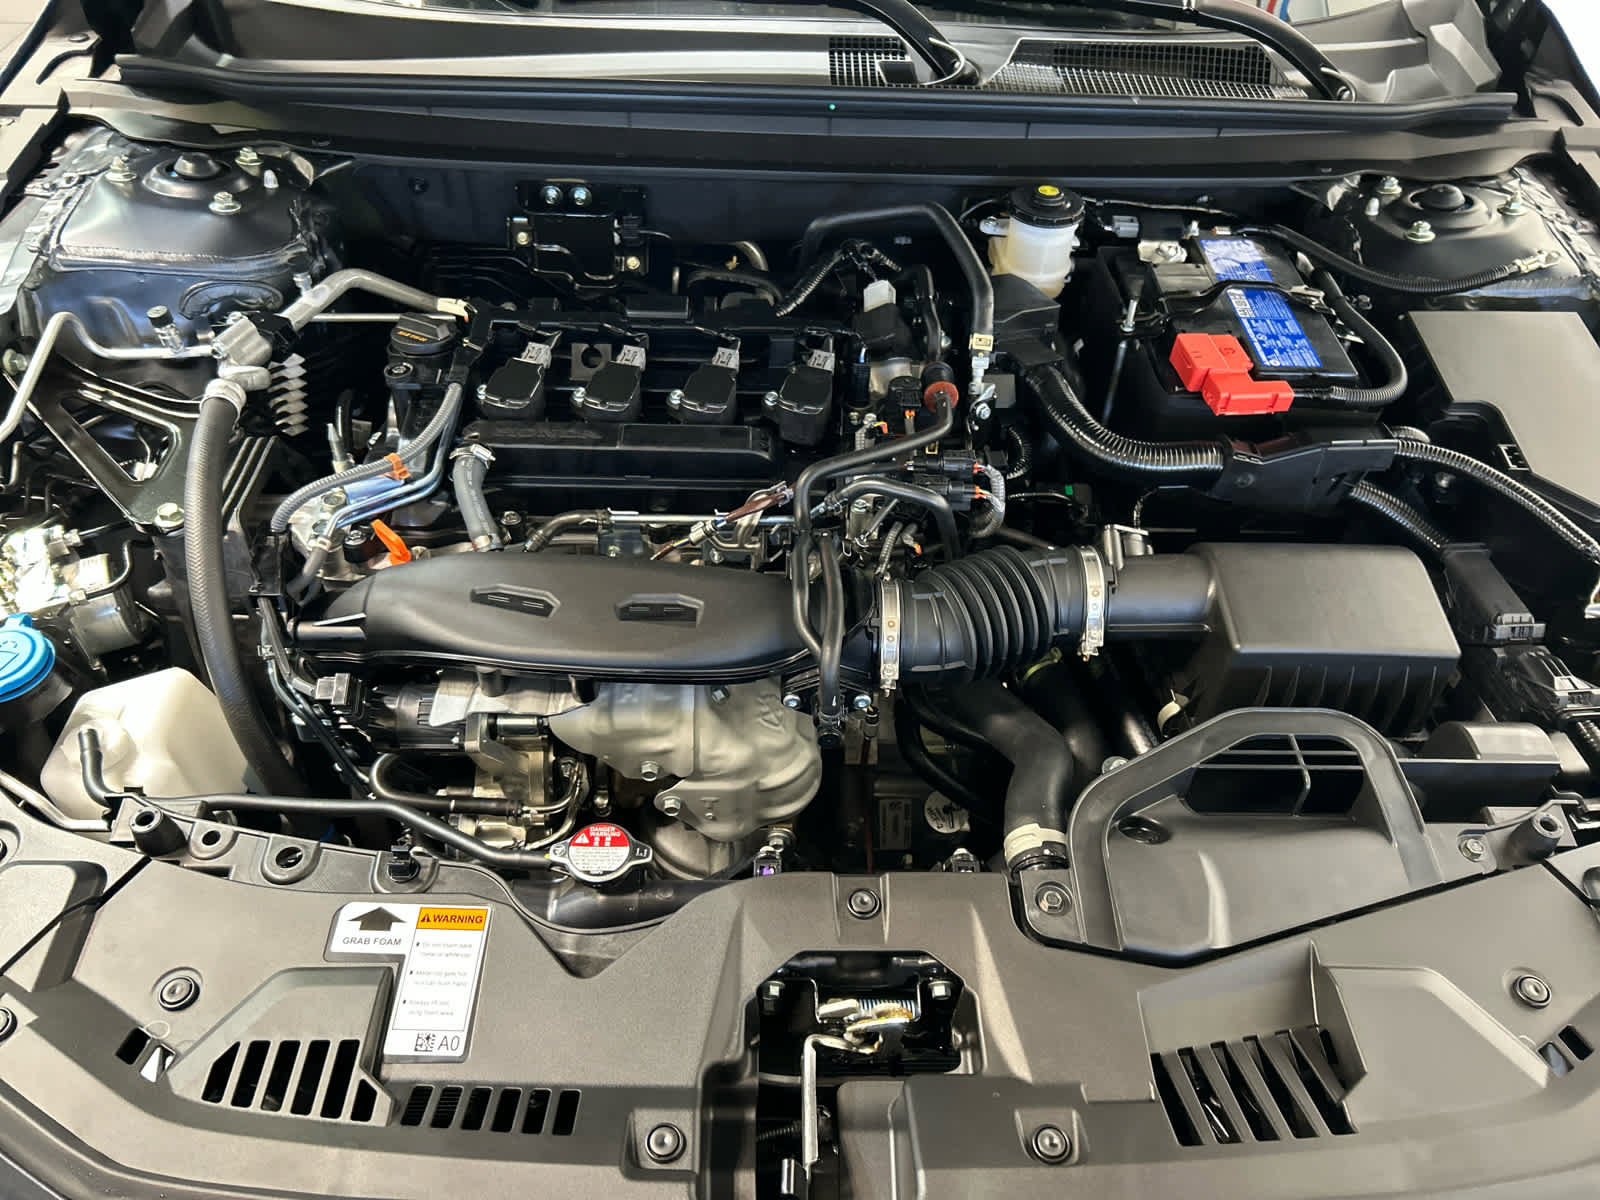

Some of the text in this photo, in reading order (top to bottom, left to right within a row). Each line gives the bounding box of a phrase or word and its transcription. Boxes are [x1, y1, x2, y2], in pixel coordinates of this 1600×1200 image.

[433, 914, 483, 924] WARNING
[342, 937, 402, 946] GRAB FOAM
[437, 1035, 461, 1051] A0
